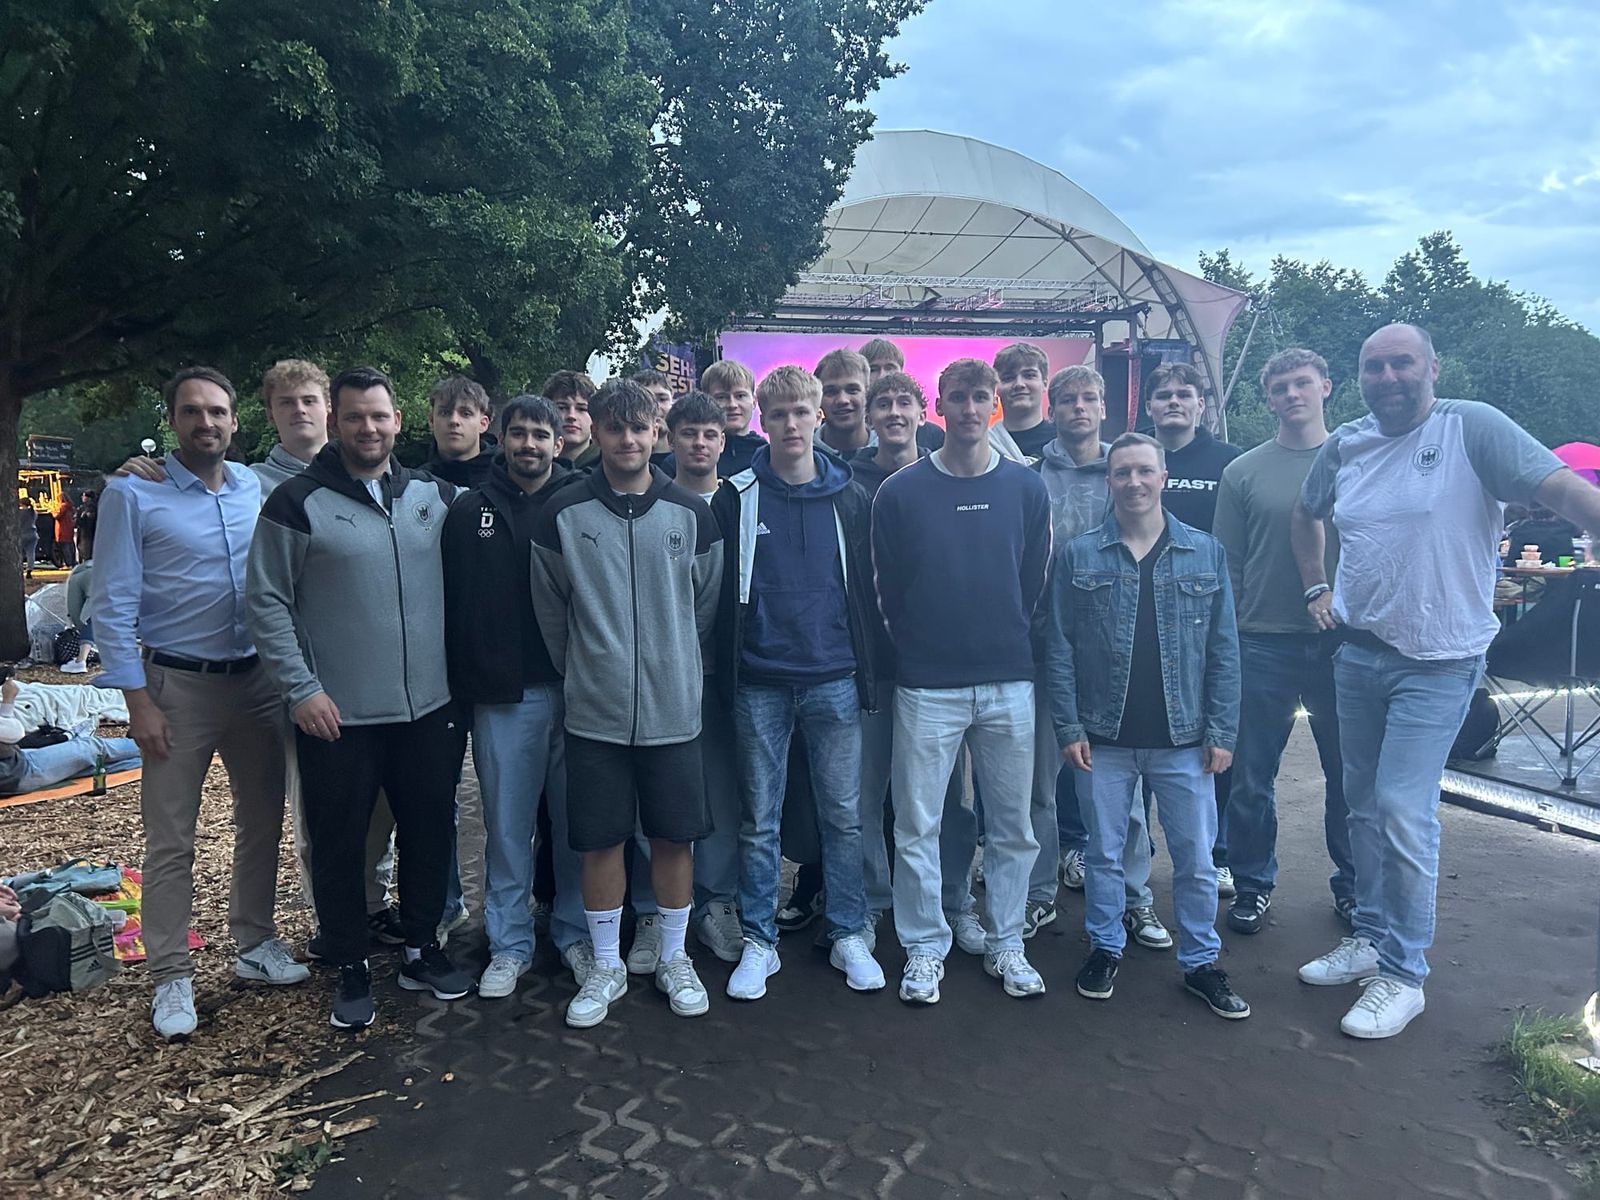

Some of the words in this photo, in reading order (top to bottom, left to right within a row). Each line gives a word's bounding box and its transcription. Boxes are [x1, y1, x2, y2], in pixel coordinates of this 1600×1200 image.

[664, 373, 696, 394] EST
[1167, 478, 1218, 491] FAST
[956, 503, 990, 512] HOLLISTER
[481, 512, 494, 528] D
